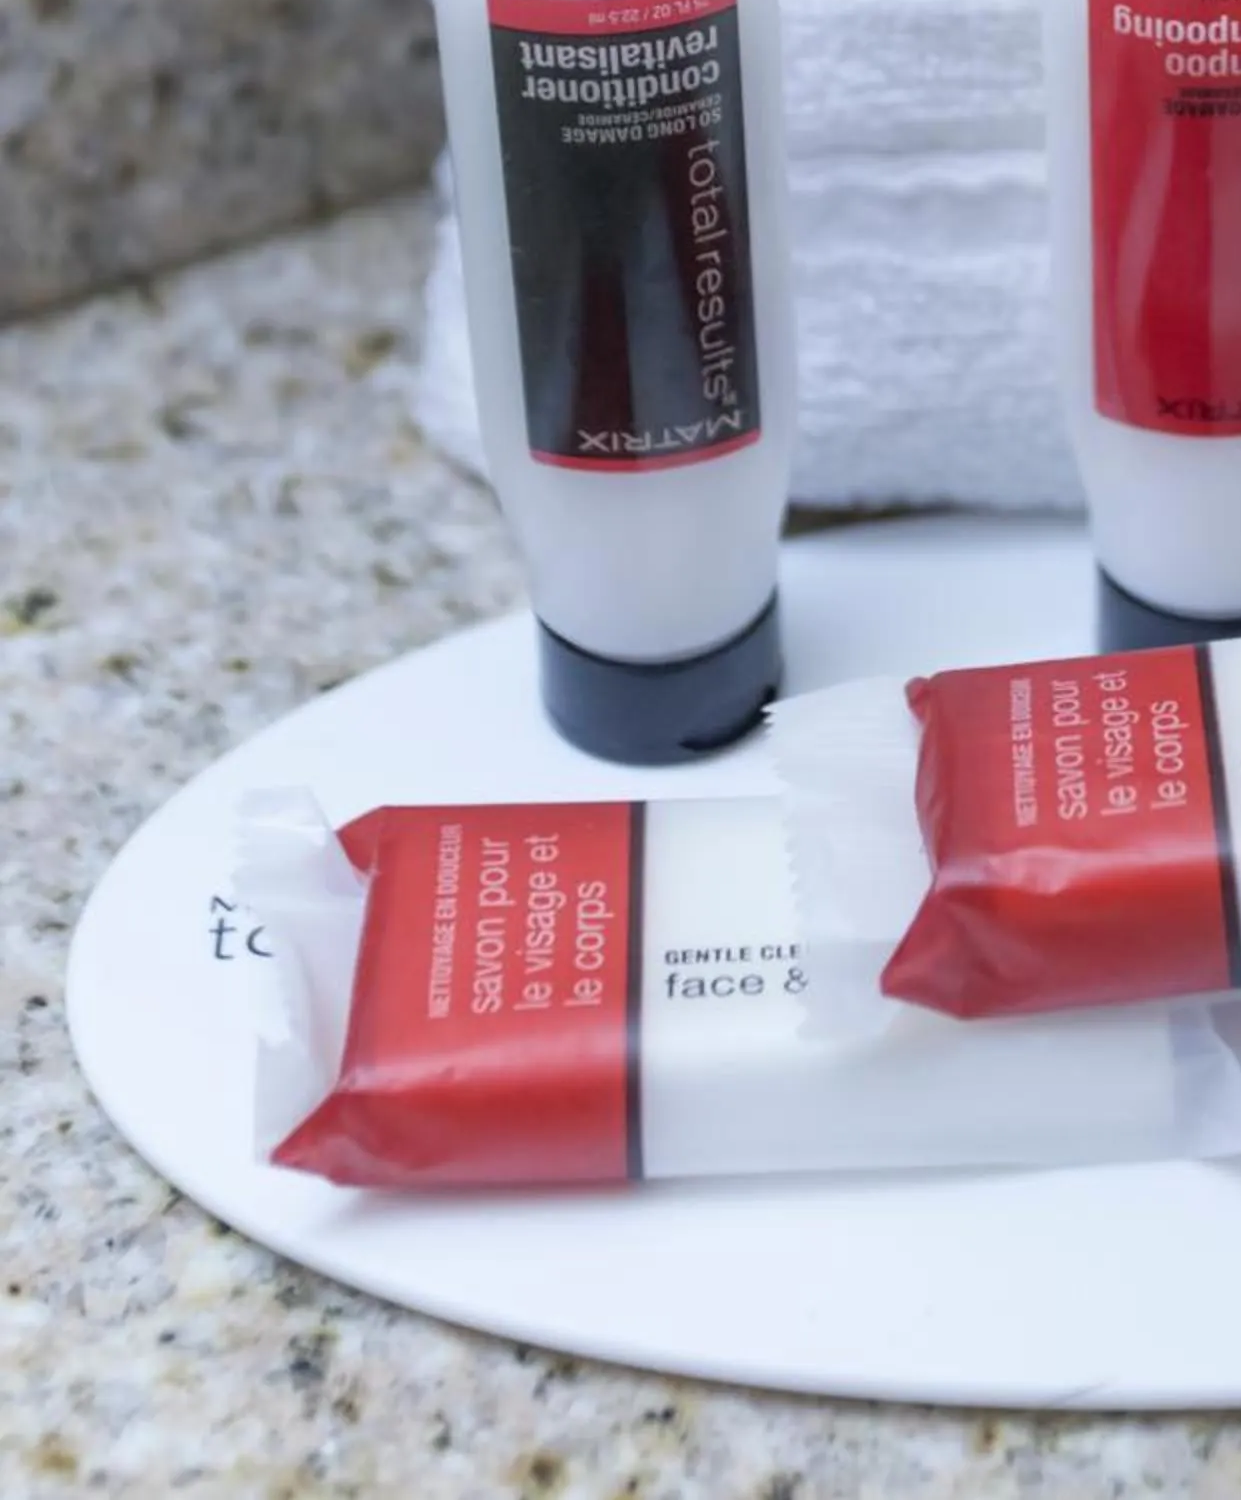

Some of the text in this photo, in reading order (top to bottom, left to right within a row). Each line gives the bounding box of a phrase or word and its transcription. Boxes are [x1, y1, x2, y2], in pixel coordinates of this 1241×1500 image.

[520, 25, 719, 71] revitalisant
[523, 61, 721, 105] conditioner
[561, 125, 642, 143] DAMAGE
[647, 116, 696, 138] LONG
[578, 409, 742, 452] MATRIX
[1050, 679, 1090, 822] savon pour
[1092, 670, 1140, 817] le visage et
[1149, 700, 1191, 810] le corps
[470, 836, 517, 1014] savon pour
[512, 832, 567, 1012] le visage et
[563, 880, 616, 1008] le corps
[664, 946, 752, 966] GENTLE
[666, 966, 810, 999] face &
